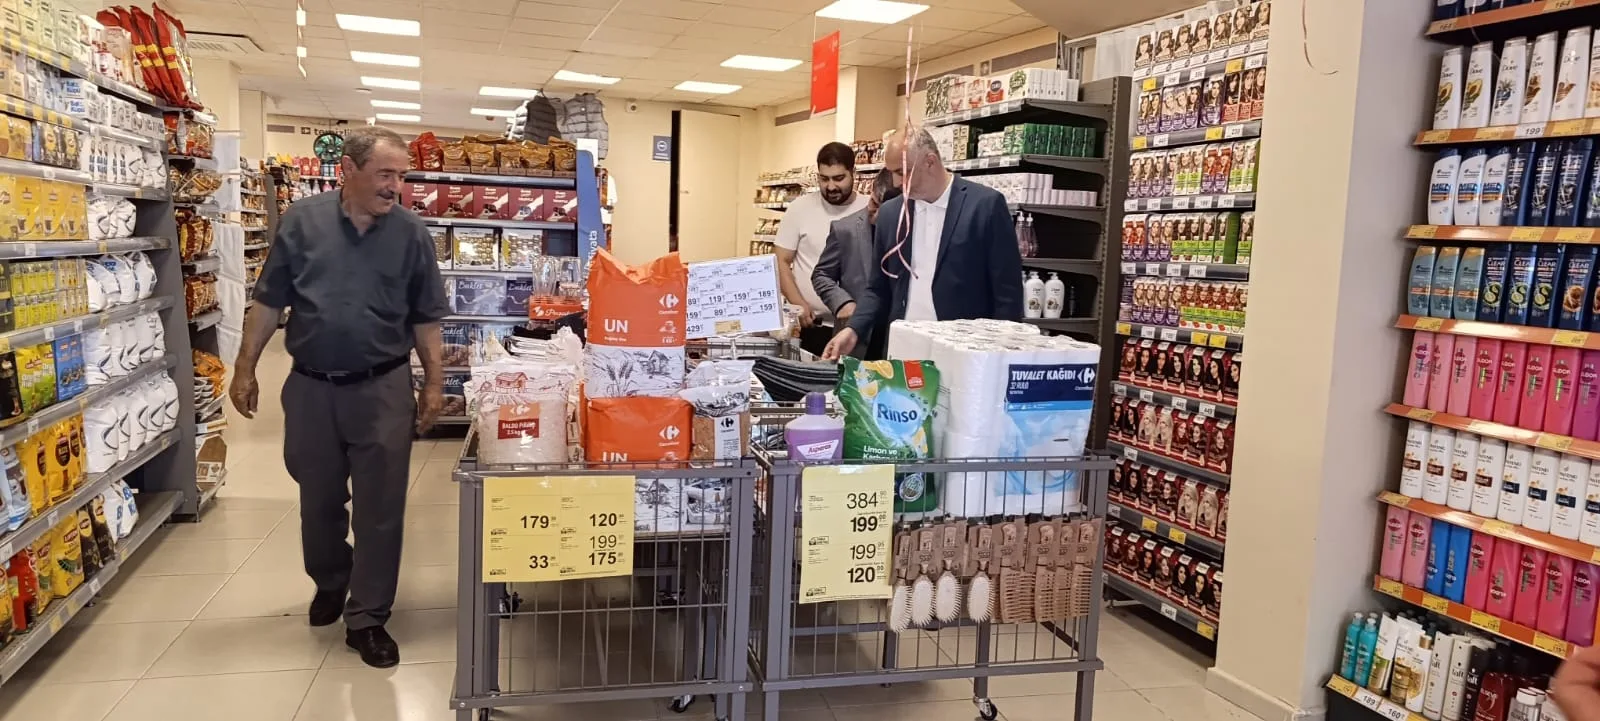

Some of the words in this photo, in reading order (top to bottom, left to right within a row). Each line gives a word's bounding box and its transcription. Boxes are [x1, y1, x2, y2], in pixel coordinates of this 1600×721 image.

[1525, 127, 1541, 135] 199
[733, 292, 747, 301] 159
[604, 318, 629, 334] UN
[1011, 370, 1046, 381] TUVALET
[1046, 367, 1076, 381] KAĞIDI
[877, 403, 918, 423] Rinso
[602, 451, 628, 463] UN
[863, 445, 887, 455] Limon
[846, 491, 879, 509] 384
[520, 515, 550, 529] 179
[589, 513, 618, 527] 120
[850, 515, 878, 532] 199
[589, 534, 617, 549] 199
[588, 552, 617, 565] 175
[850, 543, 877, 560] 199
[529, 555, 549, 569] 33
[847, 566, 876, 583] 120
[1363, 695, 1376, 706] 189
[1388, 708, 1401, 719] 160
